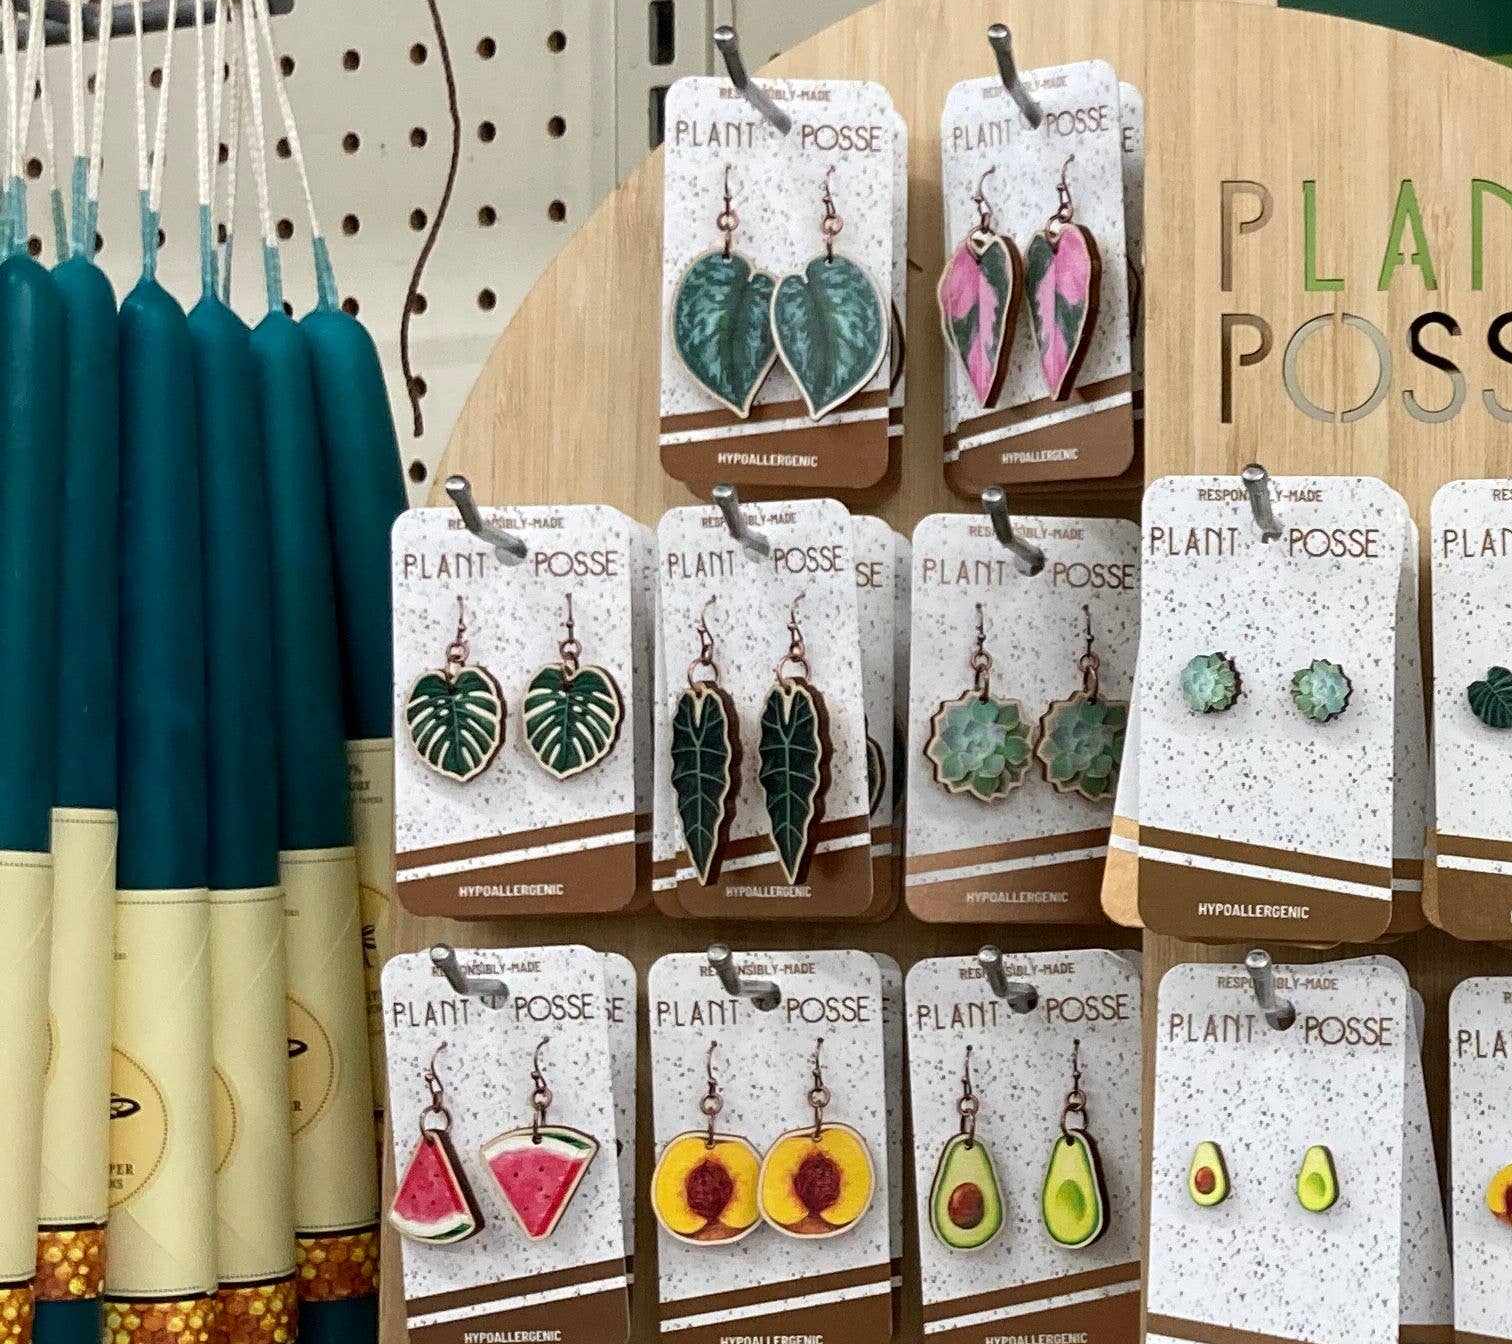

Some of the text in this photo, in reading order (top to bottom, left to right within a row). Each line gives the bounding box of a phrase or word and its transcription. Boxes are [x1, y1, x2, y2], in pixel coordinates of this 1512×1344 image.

[1150, 526, 1380, 558] PLANT POSSE
[1169, 1013, 1394, 1047] PLANT POSSE
